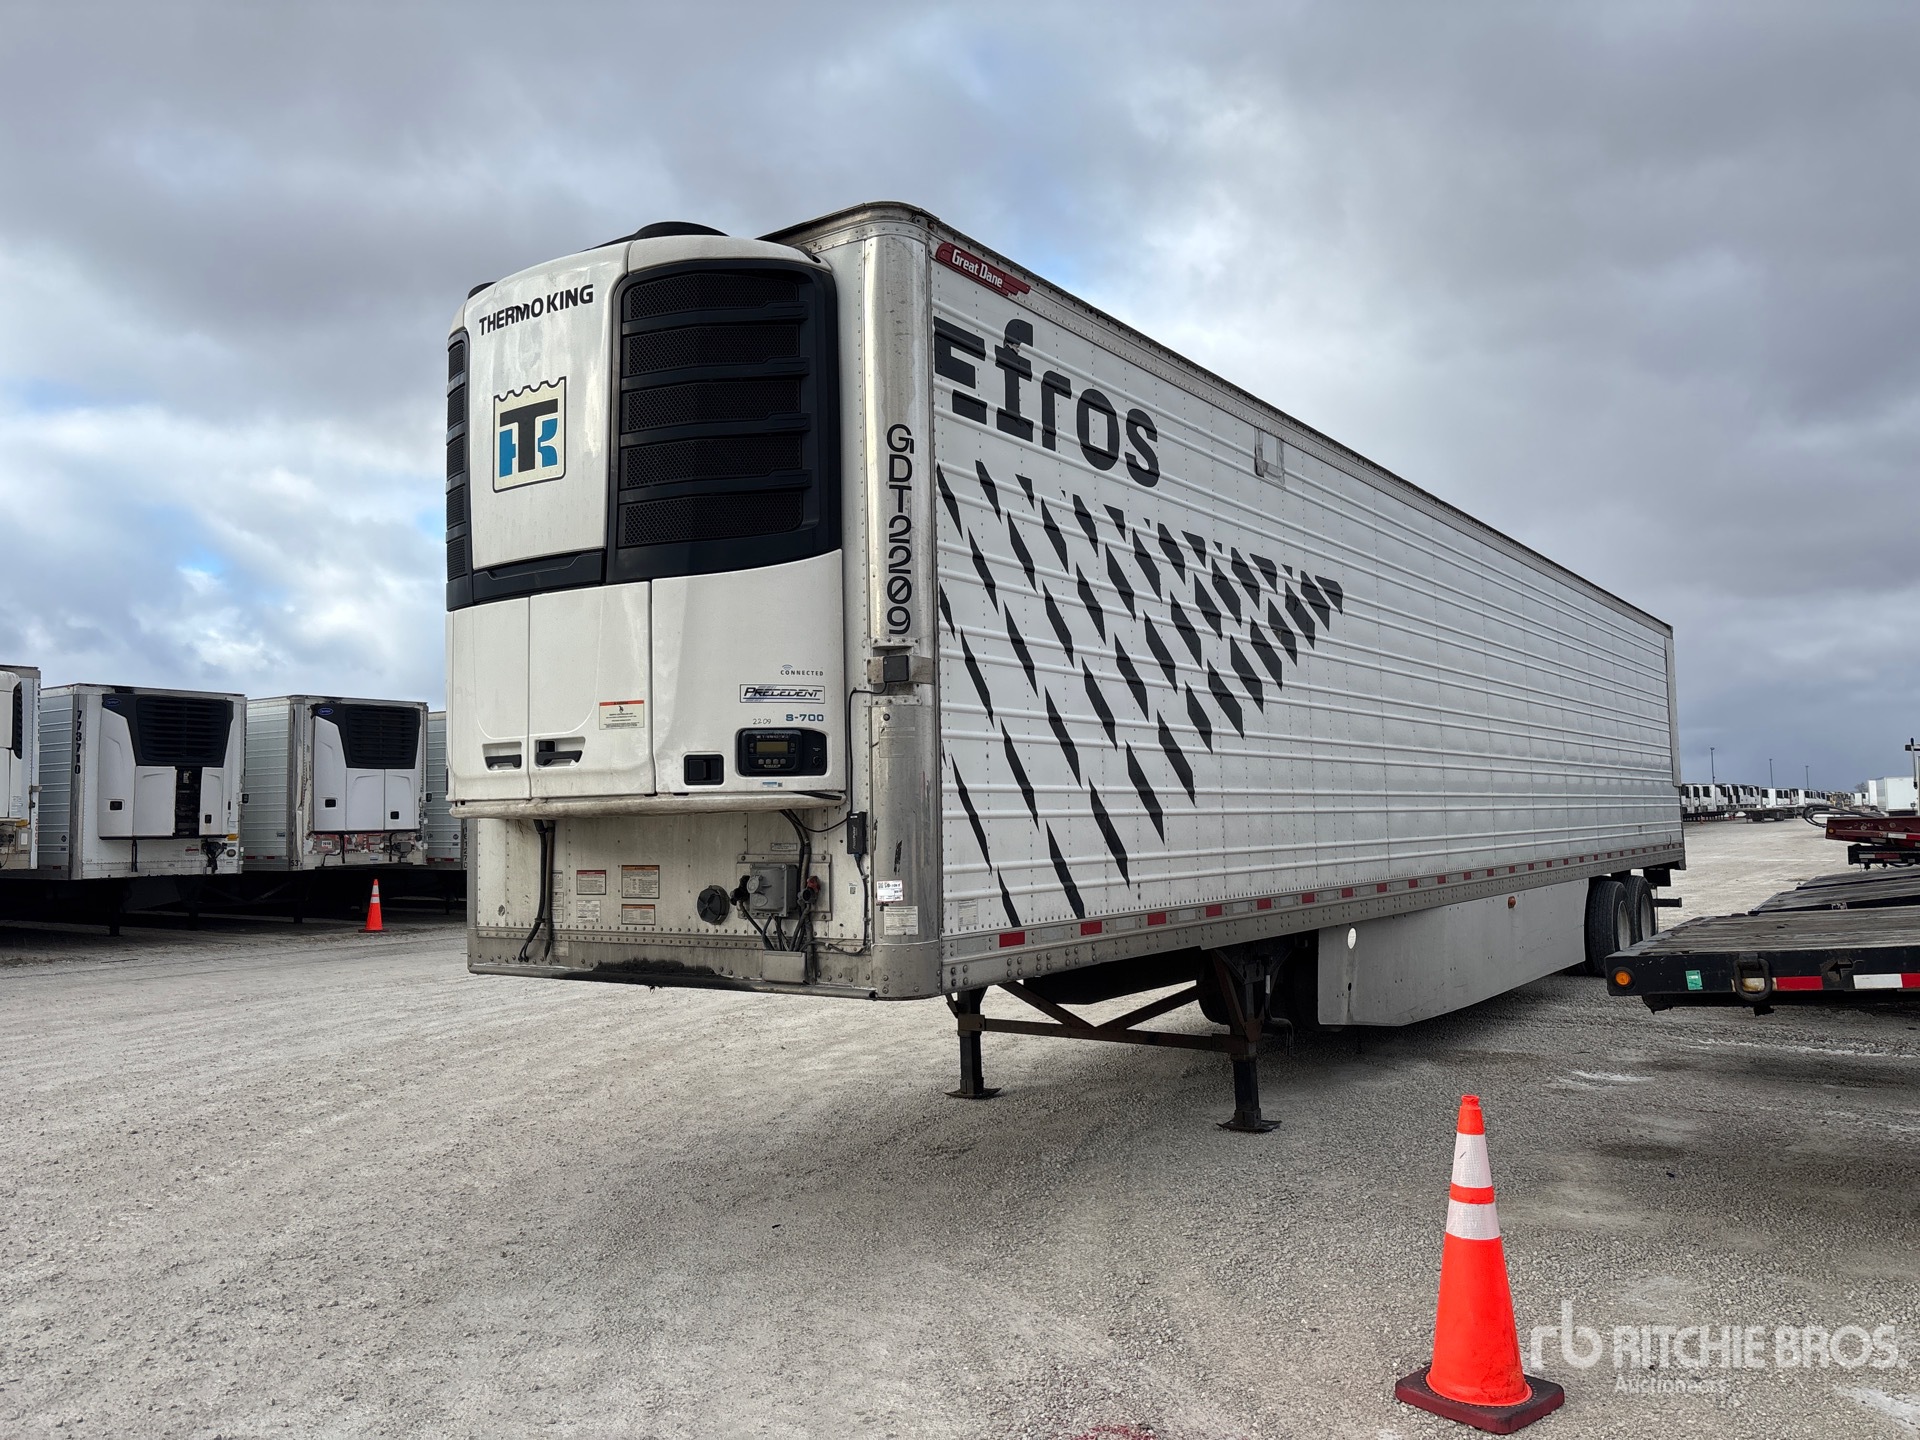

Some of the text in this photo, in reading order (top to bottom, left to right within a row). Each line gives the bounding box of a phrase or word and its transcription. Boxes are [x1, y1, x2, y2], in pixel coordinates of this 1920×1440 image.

[951, 248, 1003, 288] Great Dane
[479, 283, 594, 336] THERMO KING
[933, 316, 1161, 489] Efros
[886, 423, 915, 635] GDT2209
[743, 686, 823, 698] PRECEDENT
[752, 717, 772, 725] 2209
[785, 713, 824, 722] S-700
